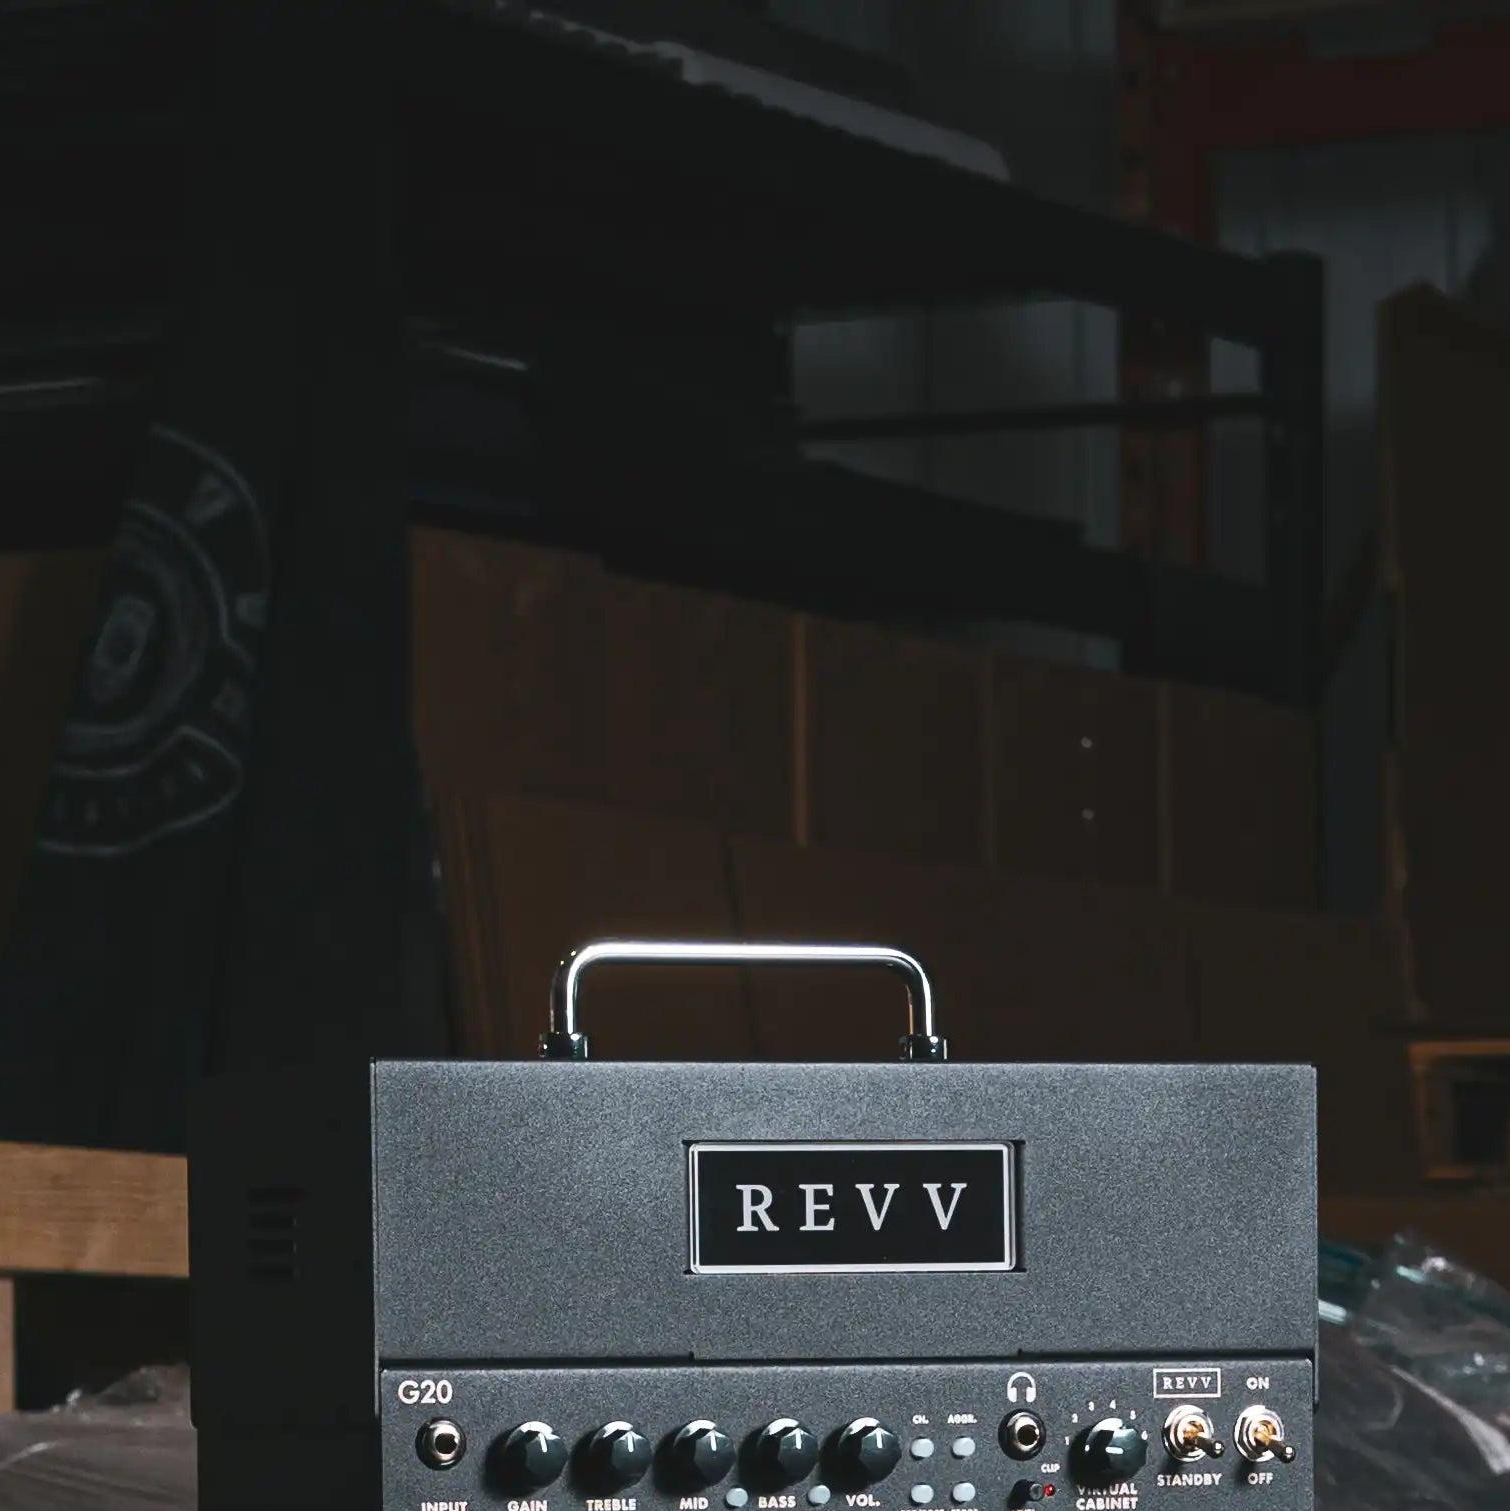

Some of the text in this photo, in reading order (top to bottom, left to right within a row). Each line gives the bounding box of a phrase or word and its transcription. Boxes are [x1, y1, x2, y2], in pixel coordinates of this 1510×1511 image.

[736, 1183, 967, 1231] REVV
[1163, 1376, 1212, 1390] REVV
[1246, 1377, 1270, 1390] ON
[397, 1379, 453, 1405] G20
[1040, 1463, 1061, 1474] CLIP
[1157, 1472, 1223, 1487] STANDBY
[1247, 1472, 1274, 1485] OFF
[585, 1498, 637, 1511] TREBLE
[679, 1497, 709, 1511] MID
[758, 1495, 796, 1509] BASS
[845, 1494, 881, 1507] VOL.
[1076, 1497, 1139, 1511] CABINET
